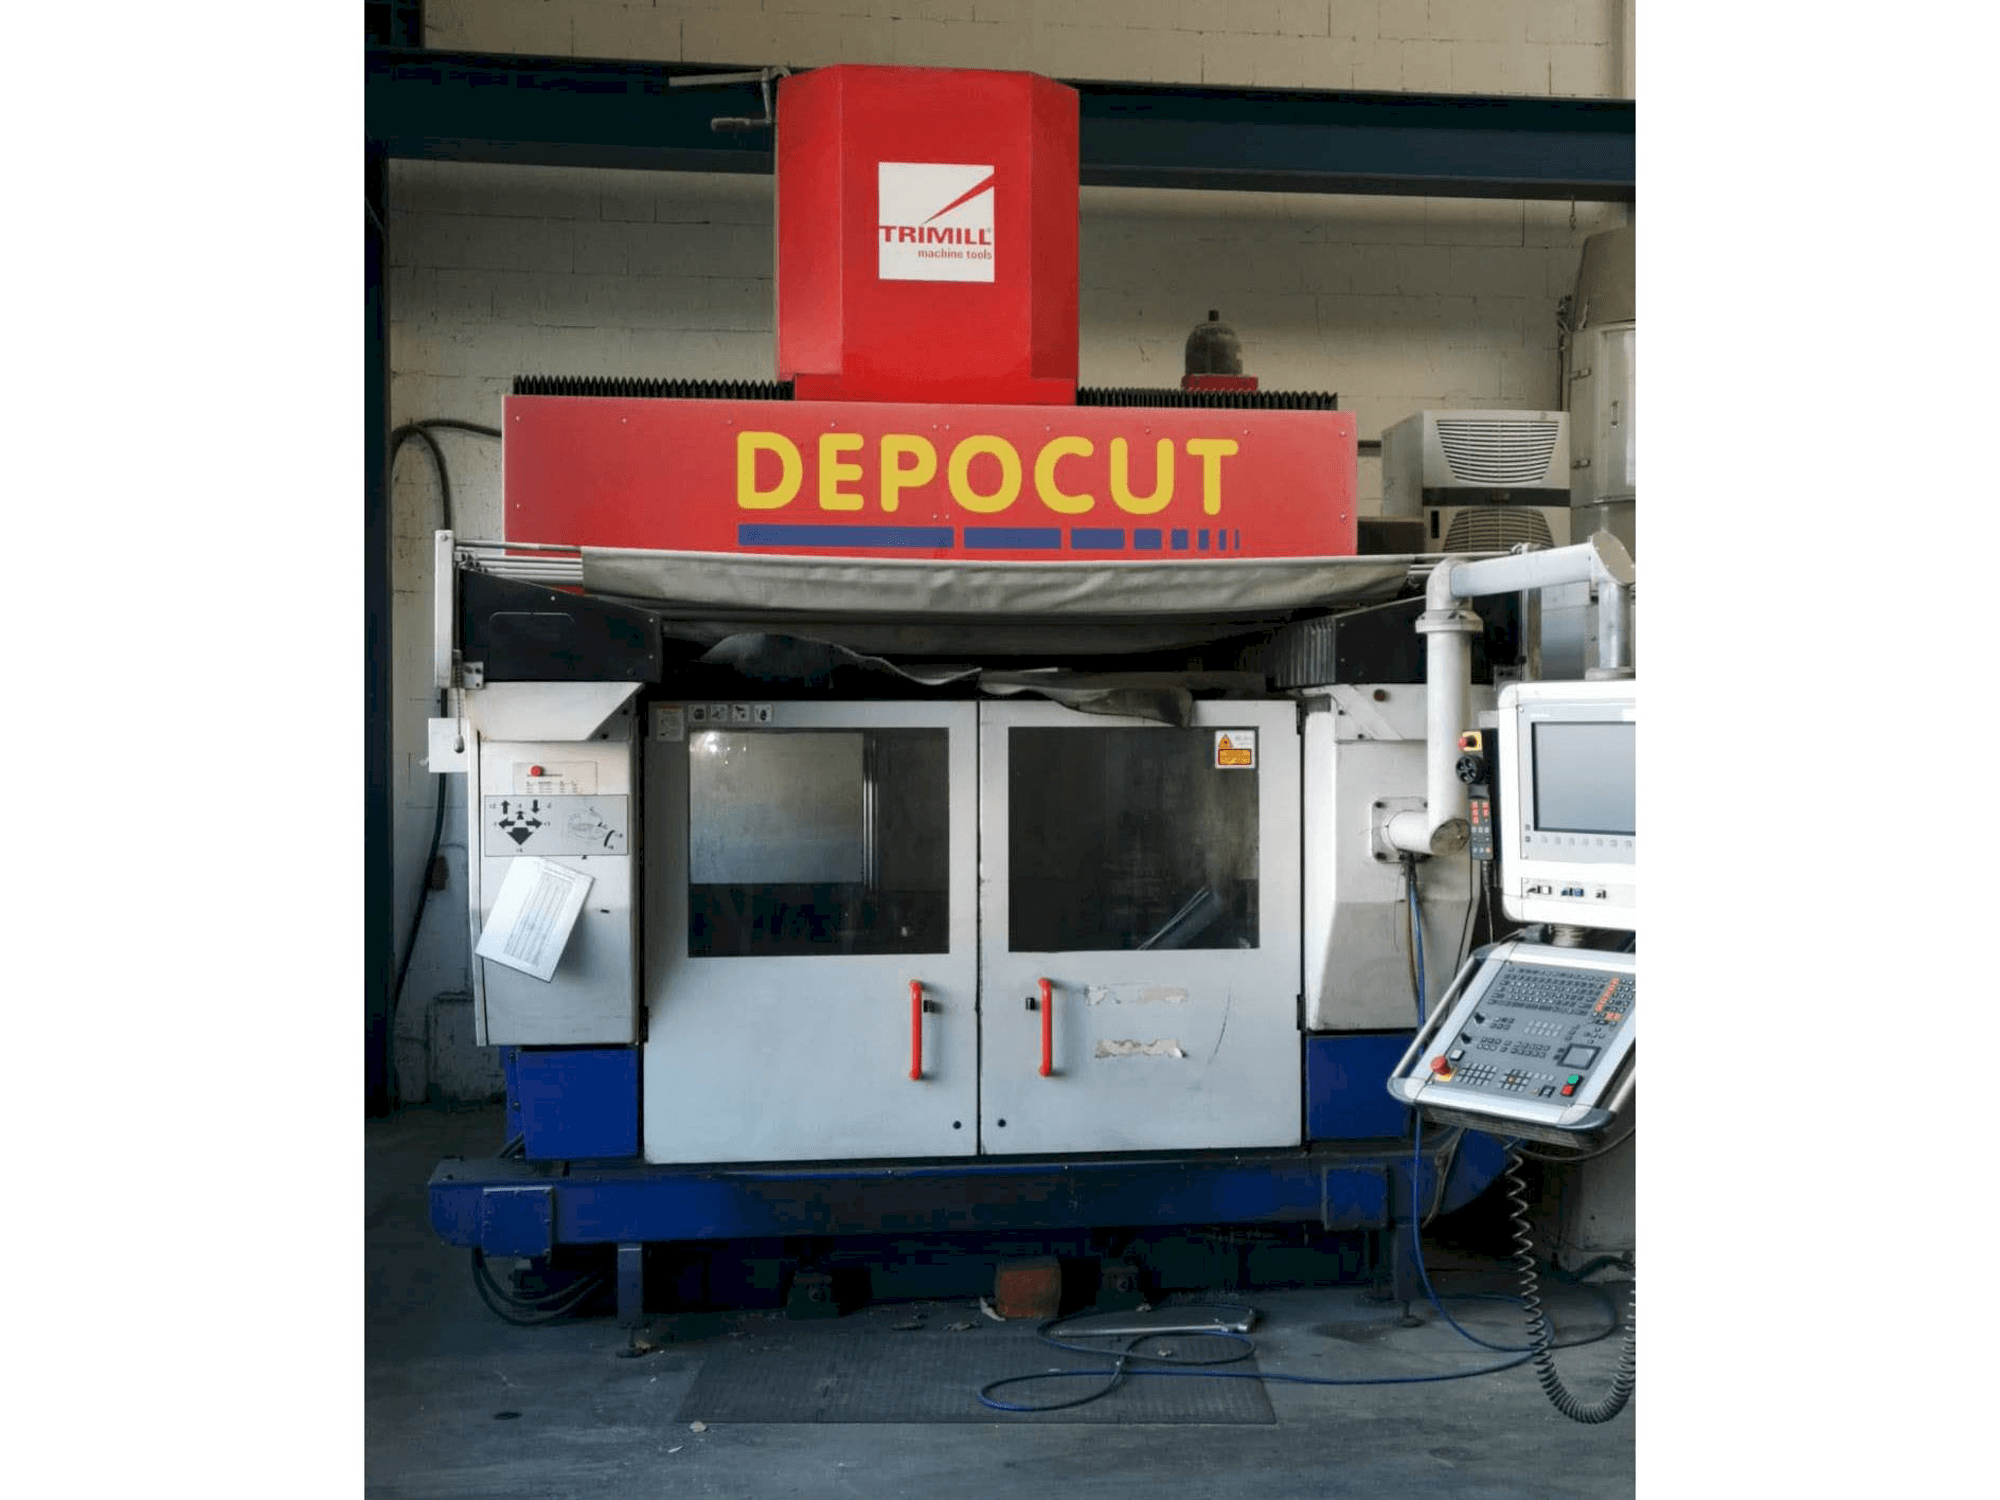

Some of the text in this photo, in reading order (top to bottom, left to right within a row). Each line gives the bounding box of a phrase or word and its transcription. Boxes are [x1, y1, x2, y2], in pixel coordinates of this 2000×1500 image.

[878, 225, 992, 246] TRIMILL
[917, 248, 992, 260] machine tools
[737, 431, 1239, 515] DEPOCUT
